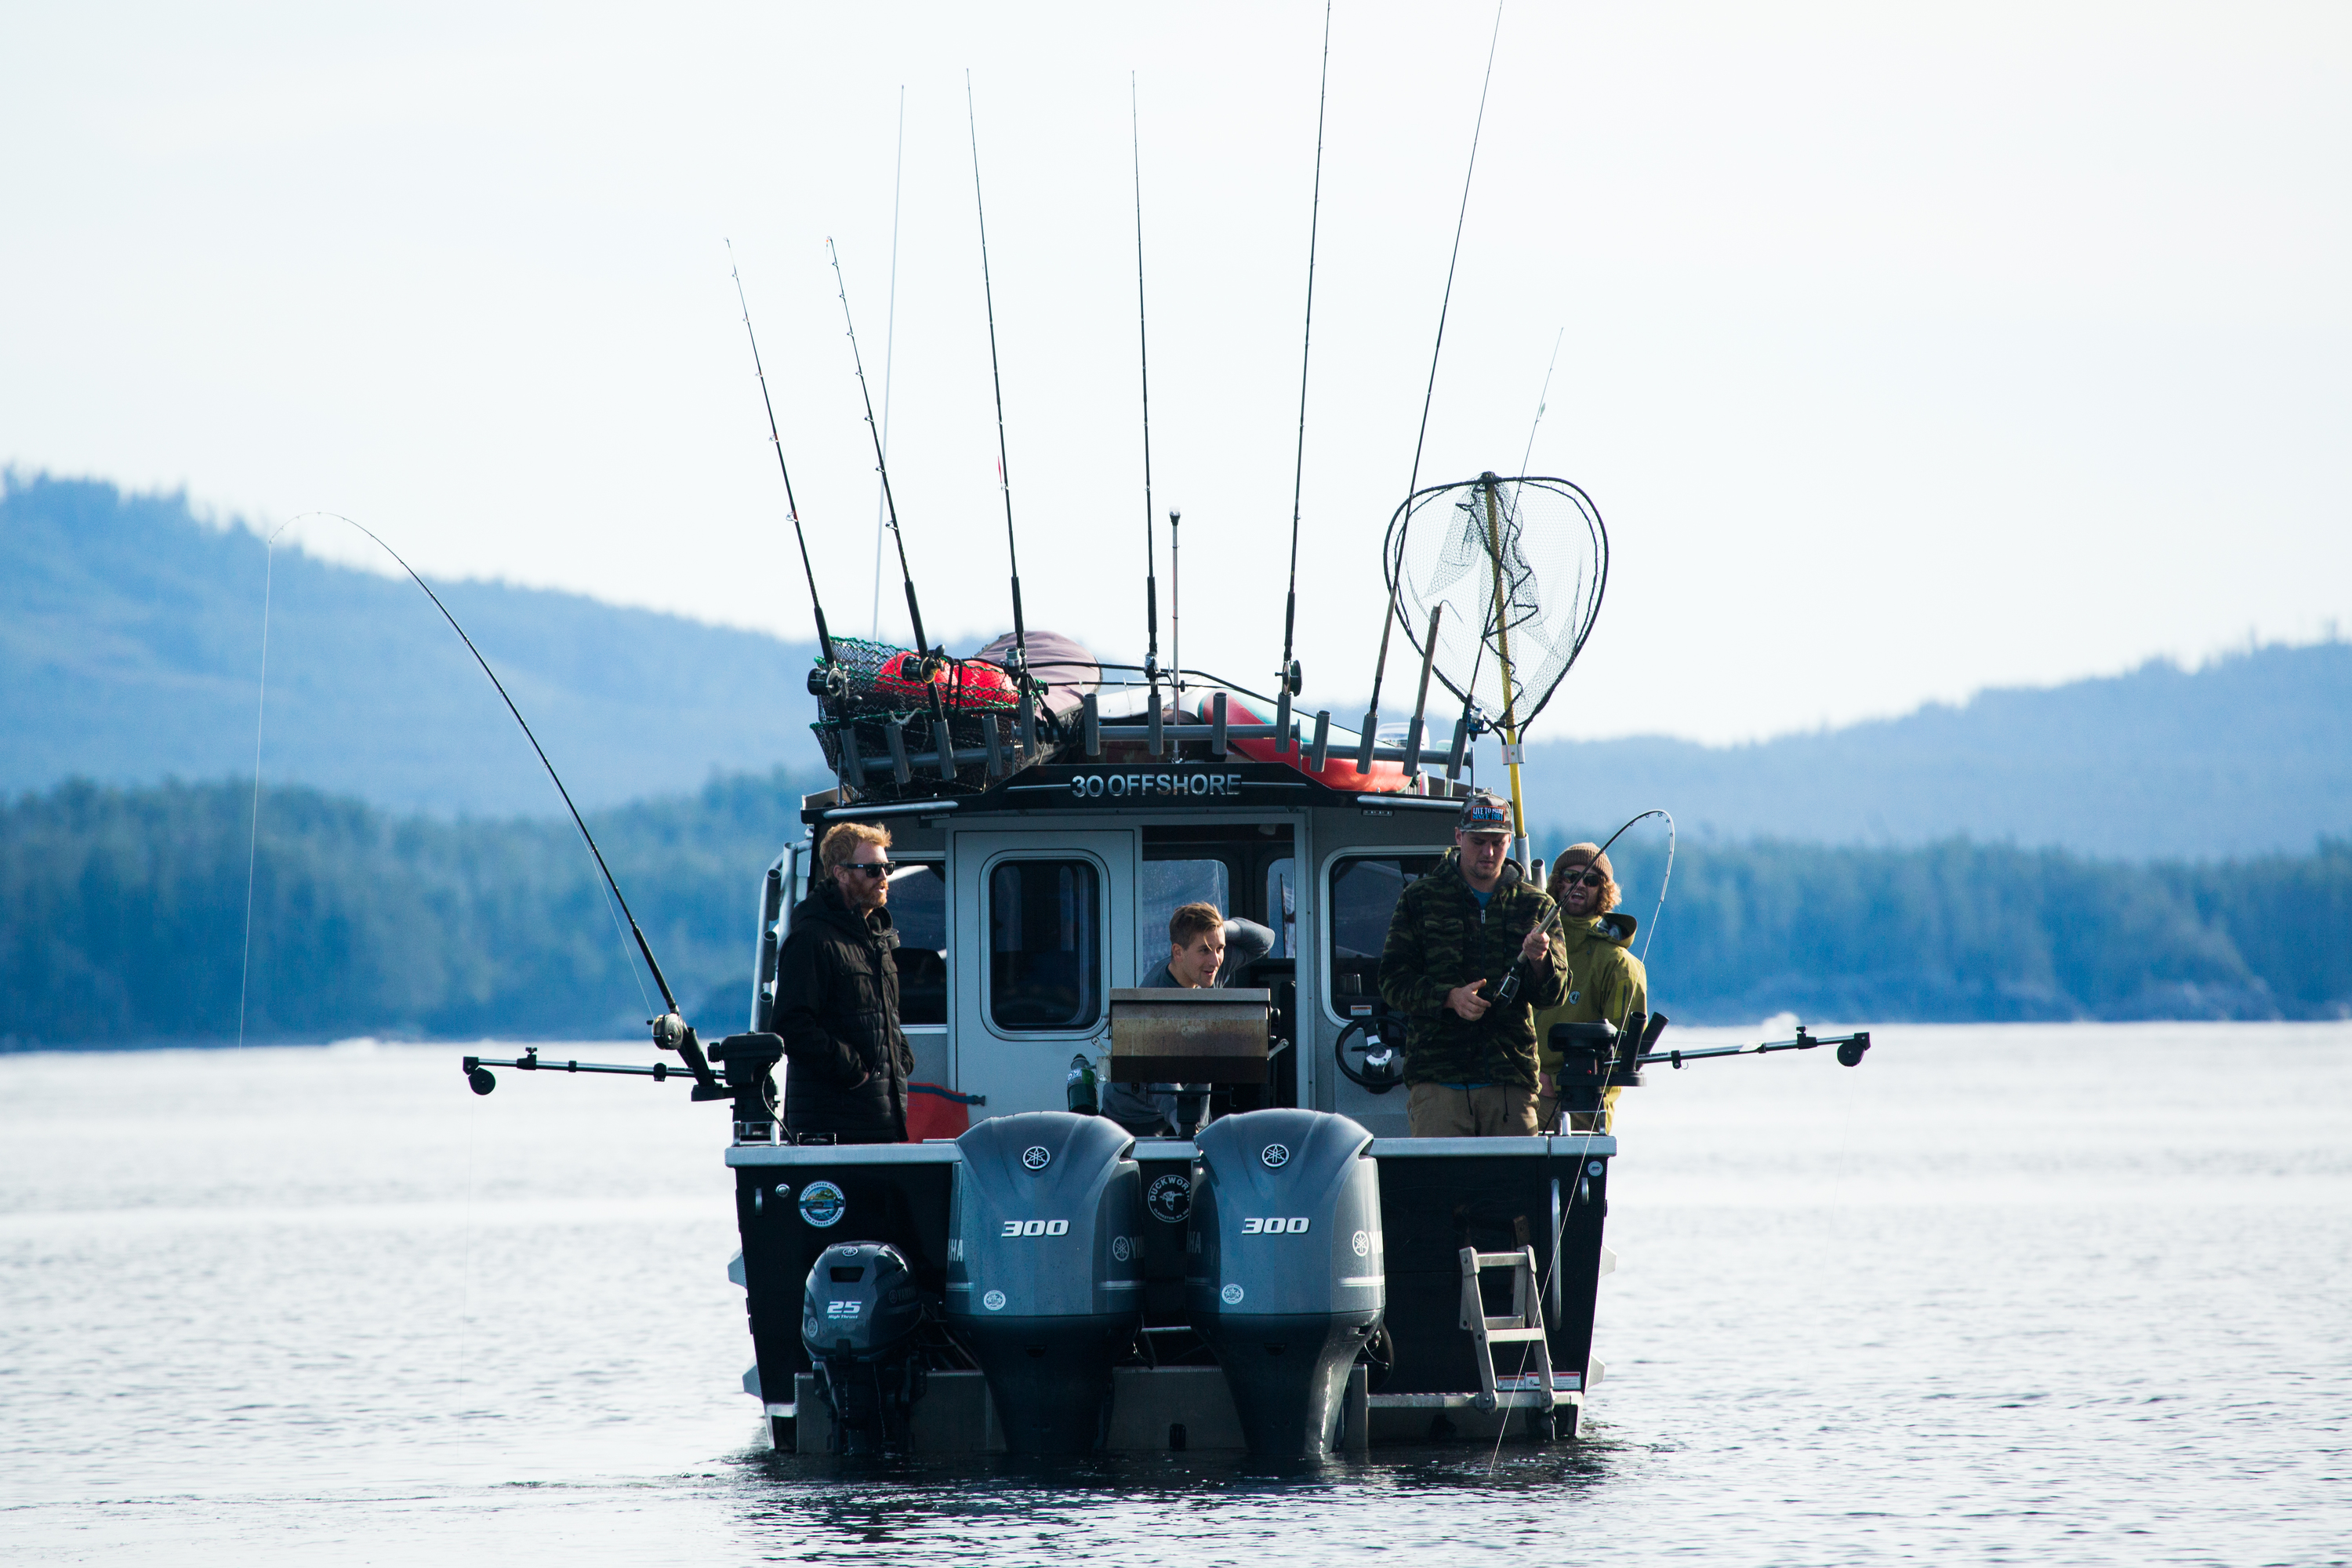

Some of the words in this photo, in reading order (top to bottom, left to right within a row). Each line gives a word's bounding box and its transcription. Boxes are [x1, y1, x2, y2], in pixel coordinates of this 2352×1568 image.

[1073, 775, 1104, 797] 30
[1108, 774, 1242, 797] OFFSHORE
[1473, 807, 1484, 815] LIVE
[1150, 1177, 1189, 1201] DUCKWOR
[1000, 1219, 1069, 1237] 300
[1241, 1217, 1311, 1234] 300
[826, 1301, 862, 1314] 25
